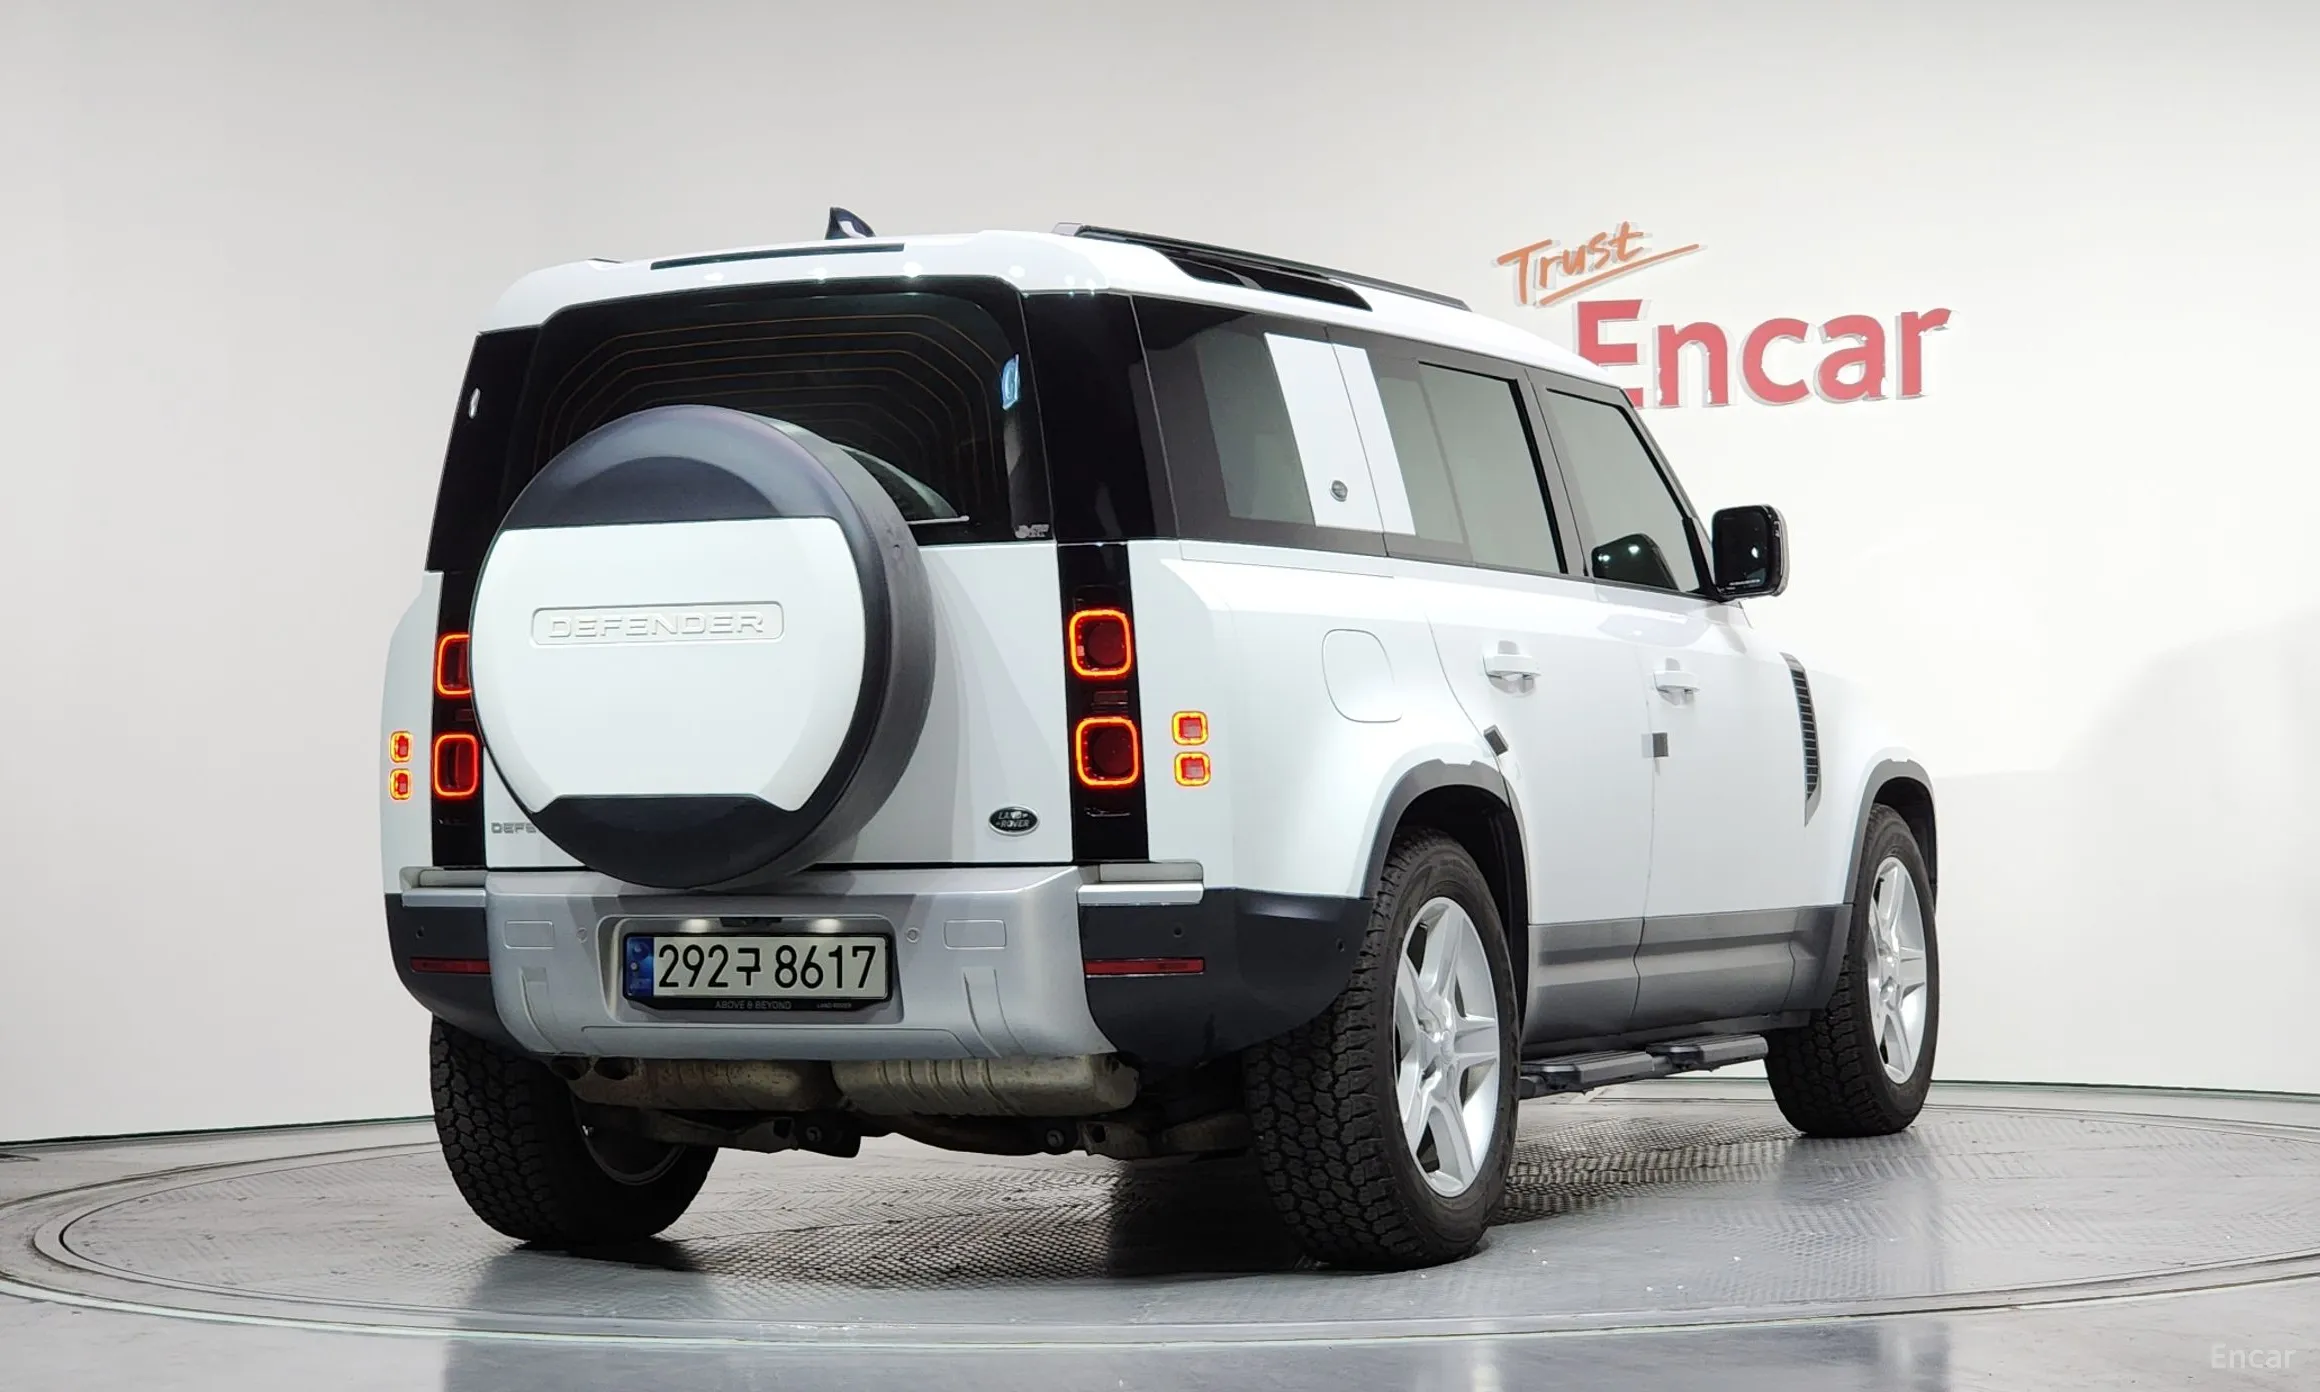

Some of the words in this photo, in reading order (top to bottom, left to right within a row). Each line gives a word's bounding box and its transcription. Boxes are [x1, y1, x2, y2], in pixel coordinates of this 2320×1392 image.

[1496, 221, 1644, 305] Trust
[1577, 298, 1953, 408] Encar
[548, 611, 765, 638] DEFENDER
[658, 944, 761, 989] 292구
[774, 944, 877, 989] 8617
[714, 1000, 745, 1010] ABOVE
[755, 1000, 792, 1010] BEYOND
